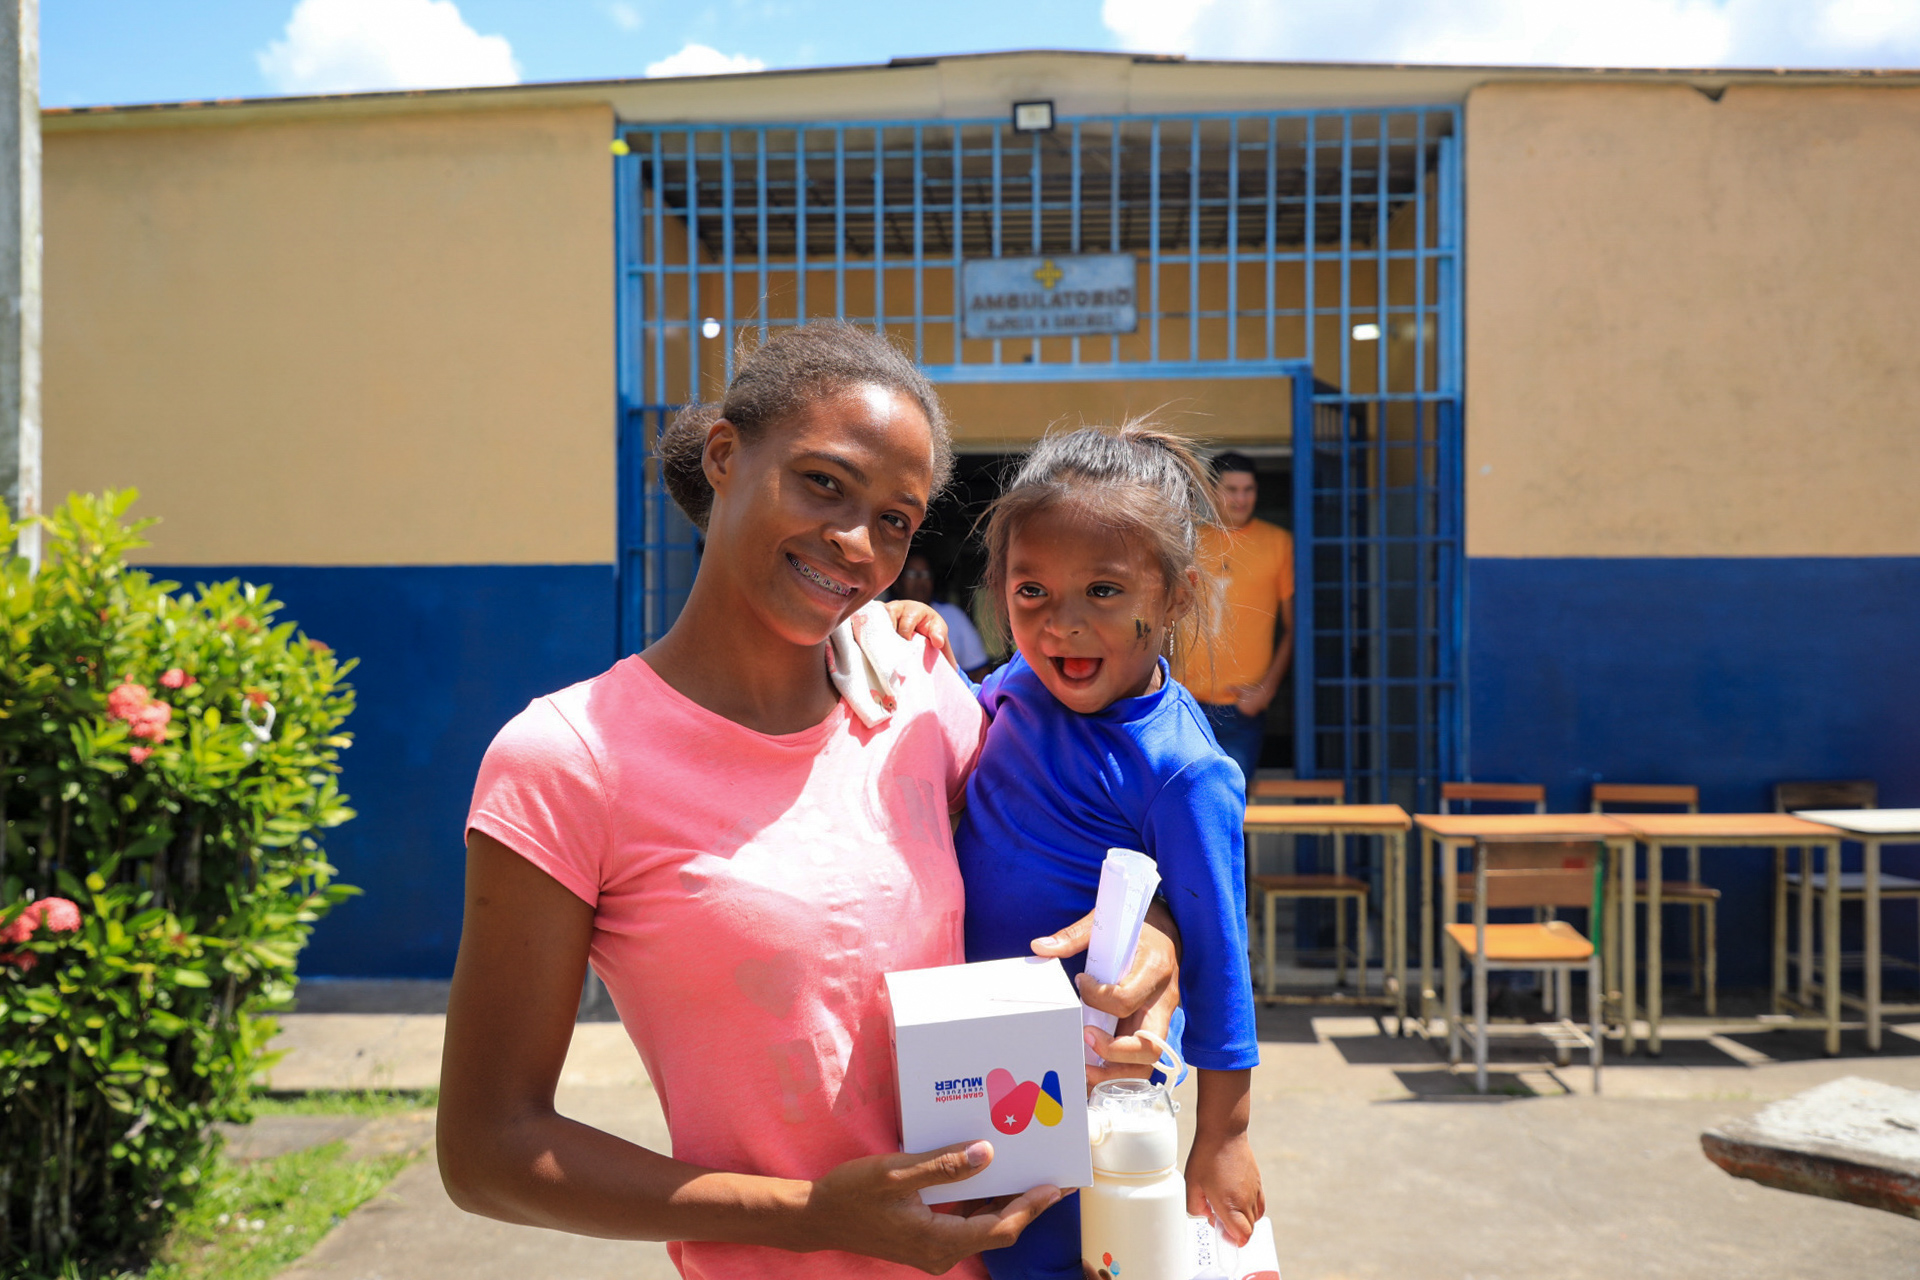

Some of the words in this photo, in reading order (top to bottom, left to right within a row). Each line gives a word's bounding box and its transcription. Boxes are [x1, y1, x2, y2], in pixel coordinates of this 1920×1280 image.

[972, 289, 1131, 310] AMBULATORIO
[934, 1076, 983, 1091] MUJER
[935, 1086, 984, 1096] VENEZUELA
[963, 1091, 984, 1099] GRAN
[935, 1094, 962, 1103] MISIÓN
